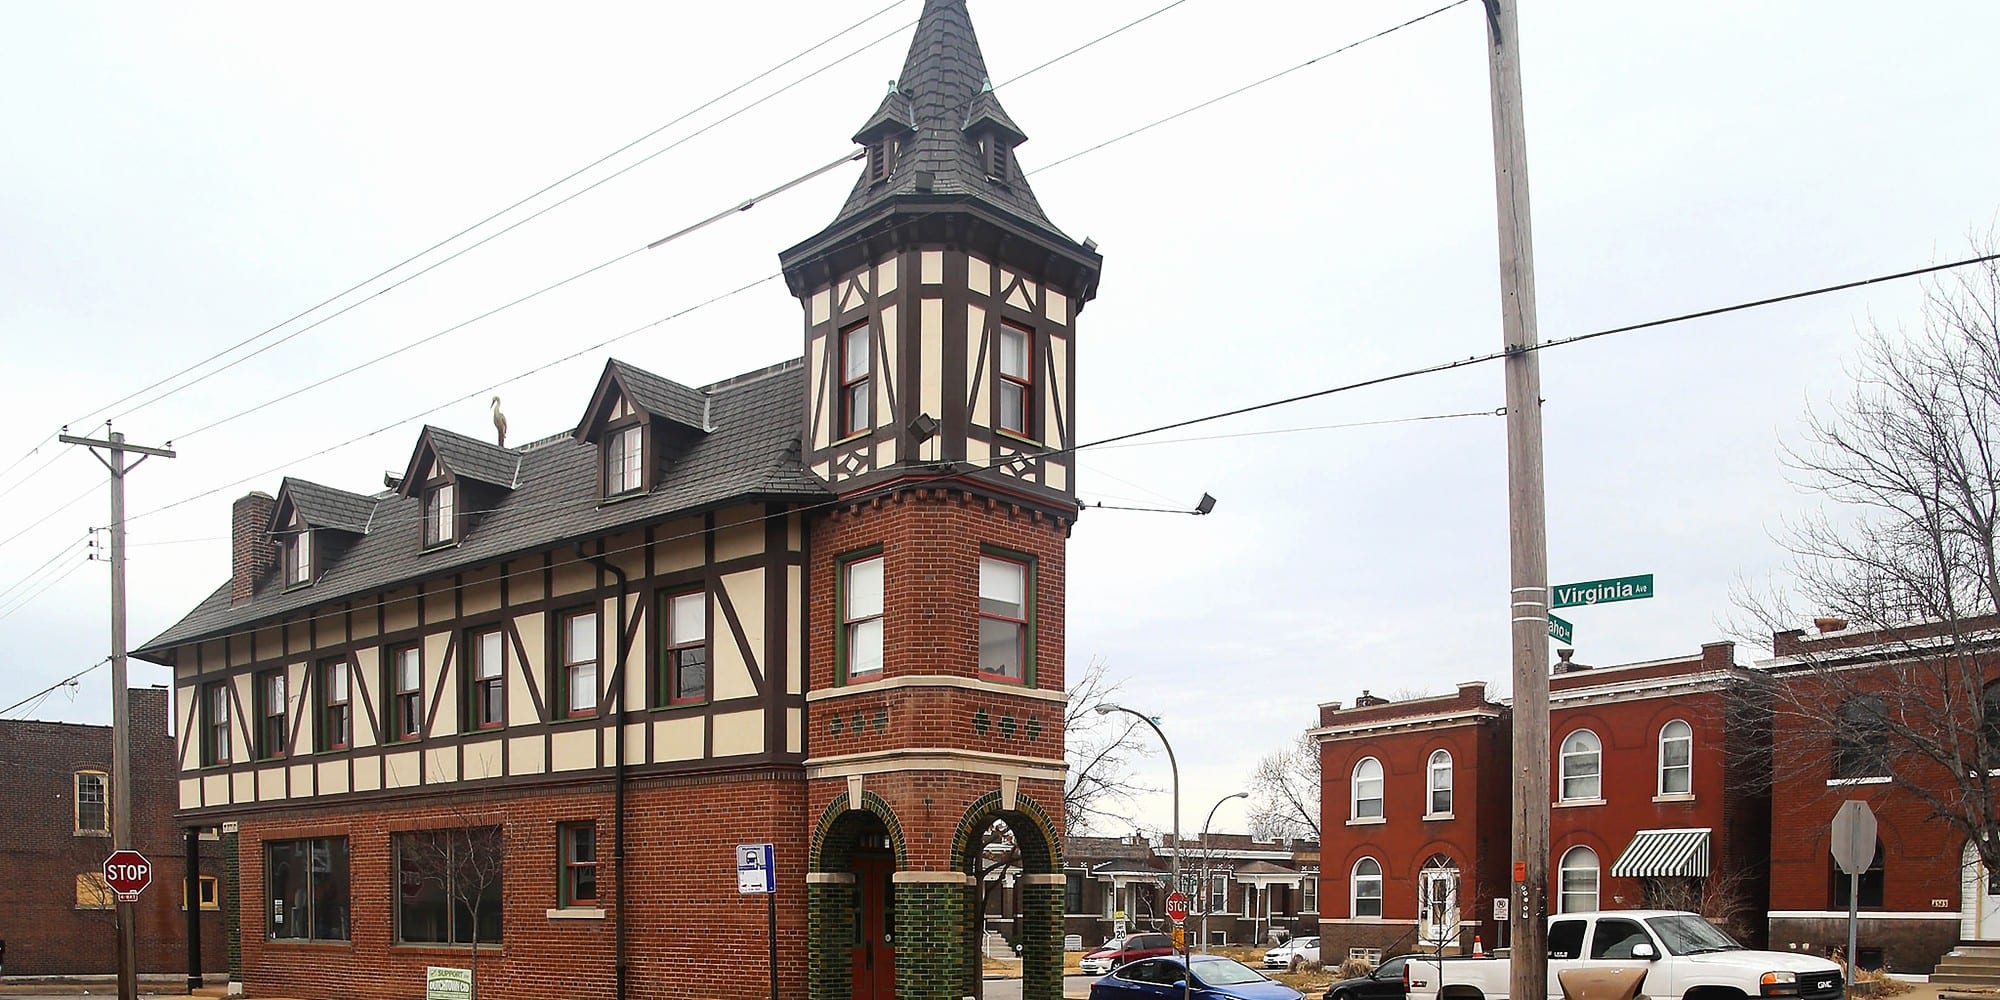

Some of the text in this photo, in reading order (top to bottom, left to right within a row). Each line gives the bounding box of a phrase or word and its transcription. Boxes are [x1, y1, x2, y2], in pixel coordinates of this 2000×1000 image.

[1558, 582, 1648, 604] Virginia Ave
[1548, 620, 1565, 637] aho
[107, 864, 148, 881] STOP
[1168, 901, 1189, 912] STOP
[1116, 930, 1126, 939] 20
[437, 969, 463, 978] SUPPORT
[1817, 980, 1833, 989] GMC
